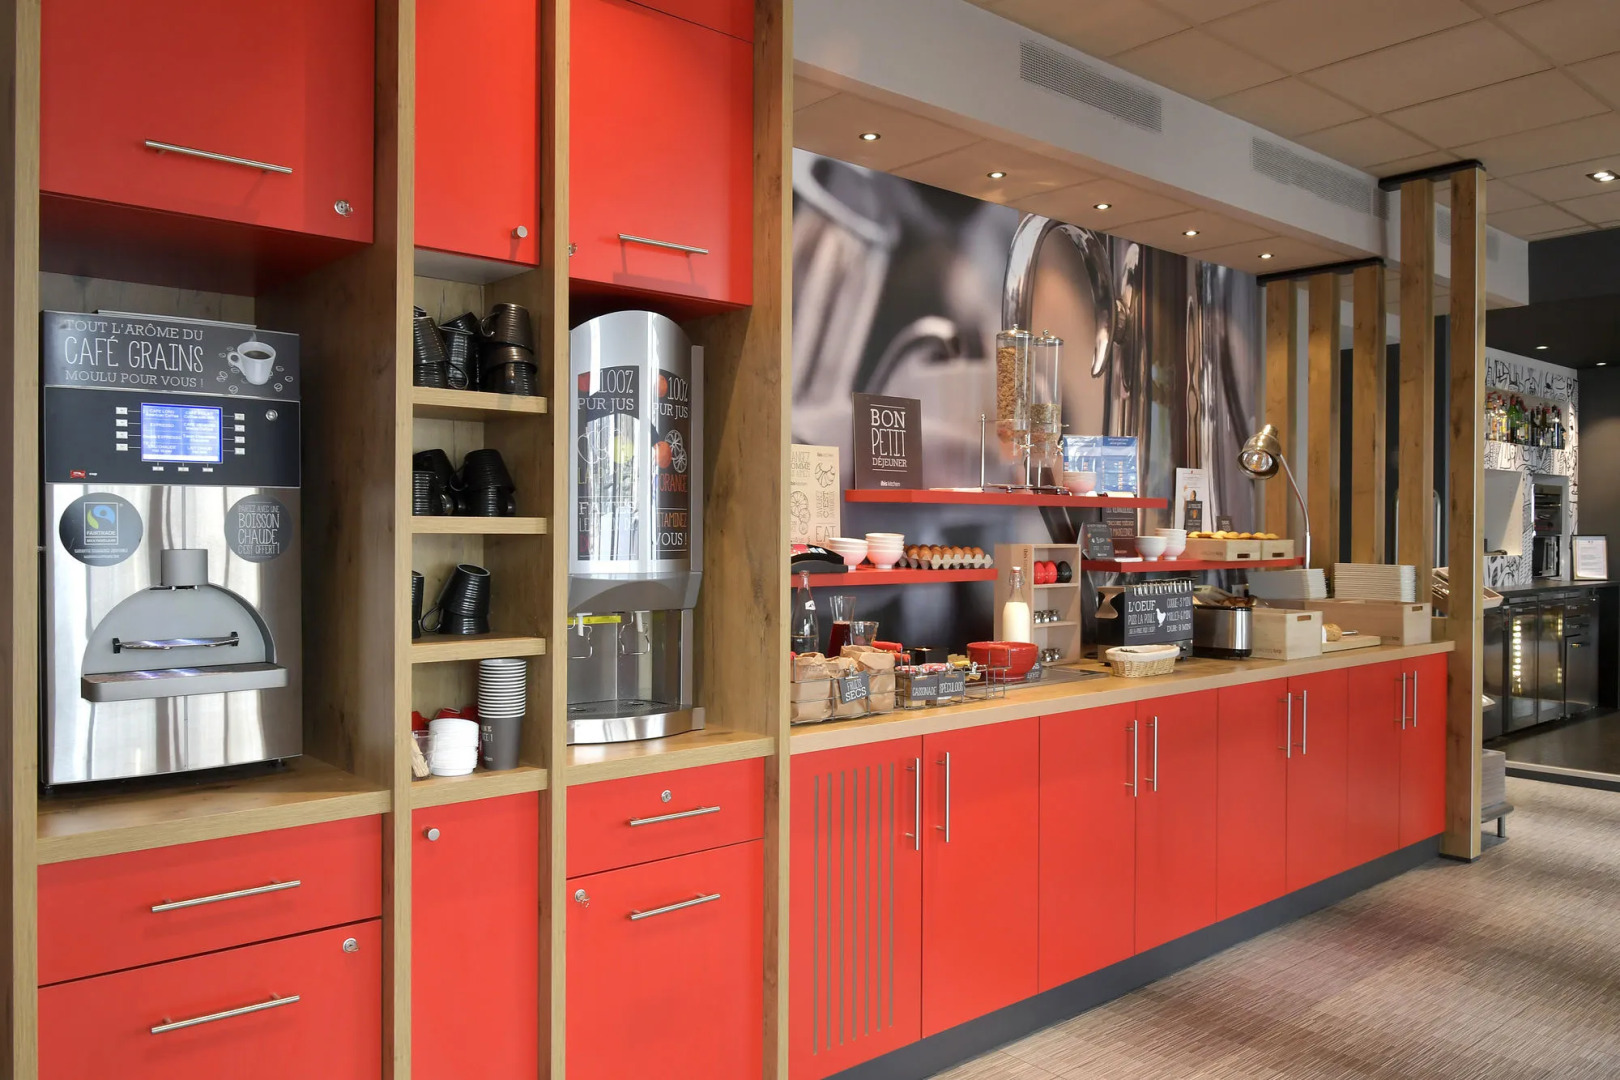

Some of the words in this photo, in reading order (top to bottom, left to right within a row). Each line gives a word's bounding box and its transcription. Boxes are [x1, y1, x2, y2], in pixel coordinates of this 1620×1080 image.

[65, 319, 107, 332] TOUT
[112, 323, 179, 339] L'ARÔME
[183, 328, 204, 341] DU
[64, 336, 119, 367] CAFÉ
[128, 340, 204, 373] GRAINS
[65, 370, 117, 383] MOULU
[120, 372, 160, 385] POUR
[163, 375, 197, 388] VOUS
[598, 369, 634, 394] 100%
[668, 376, 689, 402] 100%
[578, 397, 607, 410] PUR
[610, 397, 635, 413] JUS
[674, 405, 689, 420] JUS
[870, 408, 906, 429] BON
[871, 427, 907, 457] PETIT
[872, 456, 908, 468] DÉJEUNER
[238, 512, 280, 529] BOISSON
[655, 532, 683, 546] VOUS
[815, 525, 837, 543] EAT
[1128, 600, 1156, 613] L'OEUF
[845, 686, 867, 702] SECS
